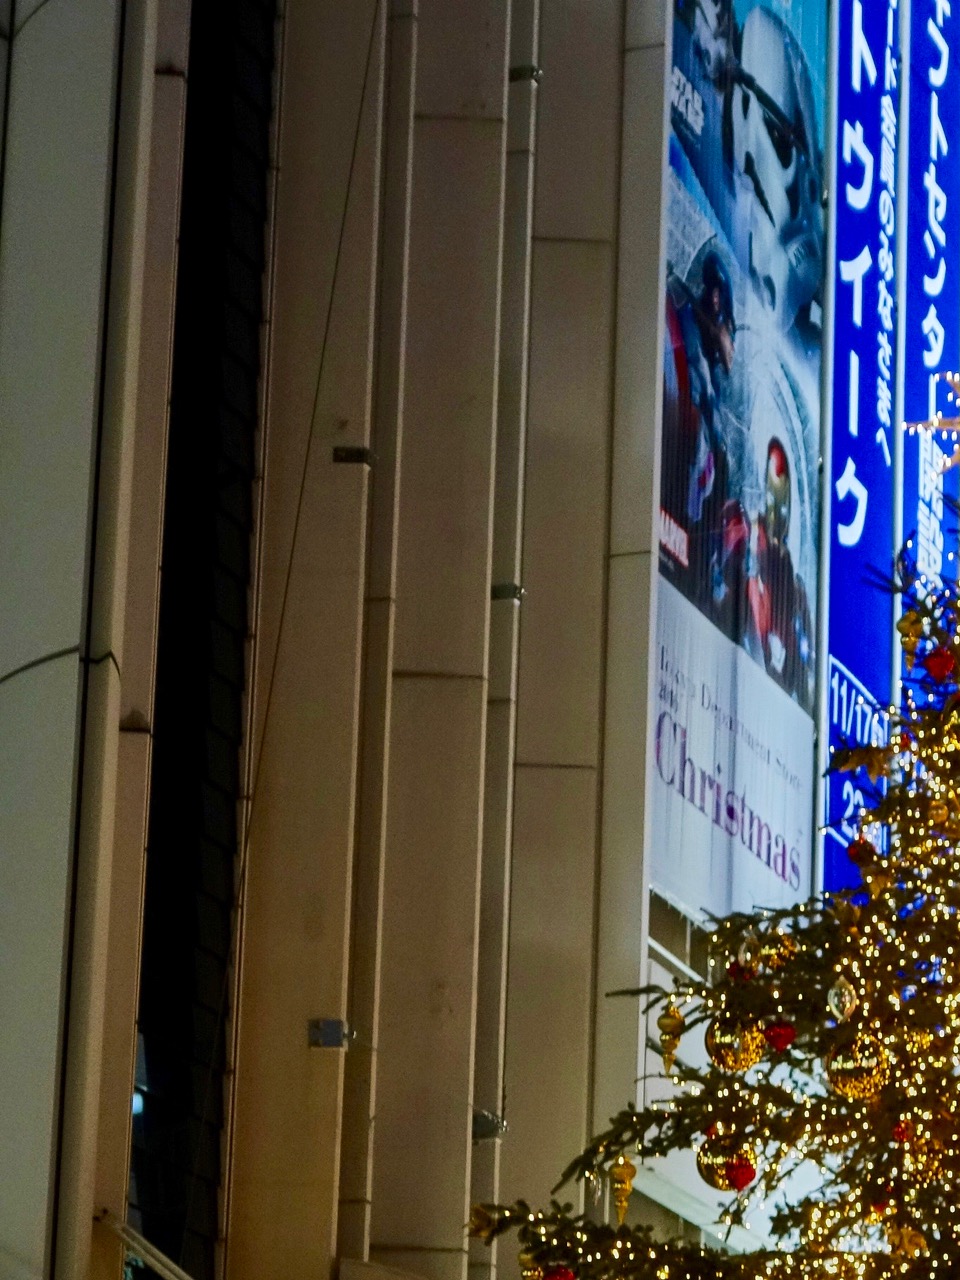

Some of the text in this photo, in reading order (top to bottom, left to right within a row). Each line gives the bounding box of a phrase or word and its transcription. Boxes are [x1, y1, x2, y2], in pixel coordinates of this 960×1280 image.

[875, 0, 898, 468] ード会員のみなさまへ
[655, 711, 801, 892] Christmas
